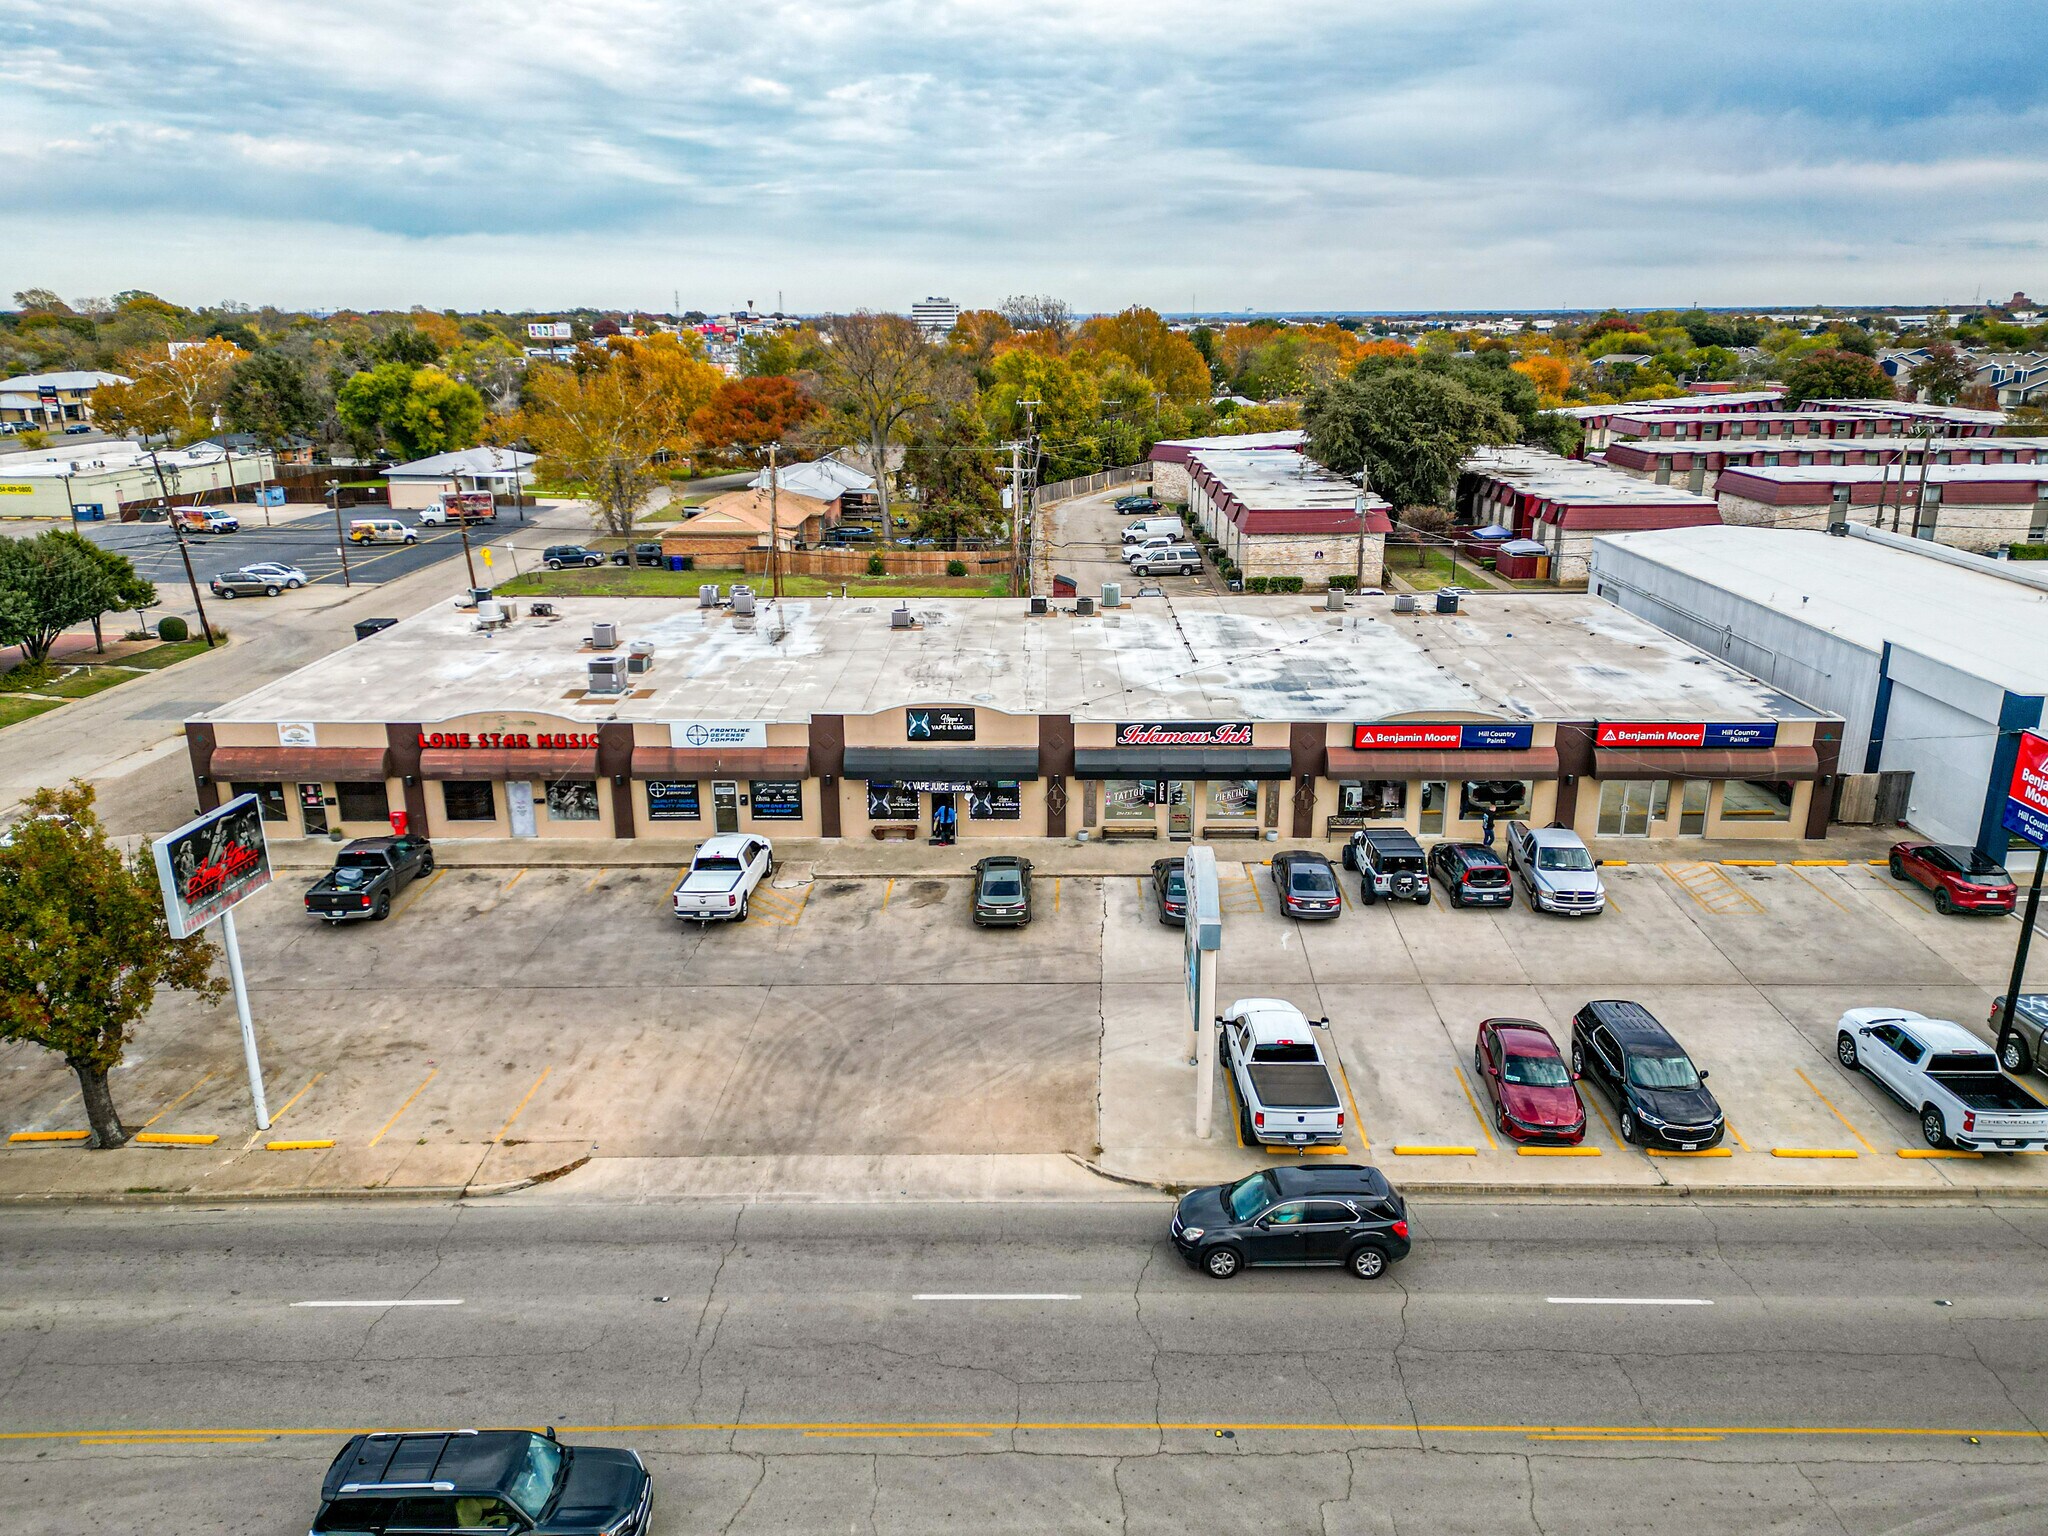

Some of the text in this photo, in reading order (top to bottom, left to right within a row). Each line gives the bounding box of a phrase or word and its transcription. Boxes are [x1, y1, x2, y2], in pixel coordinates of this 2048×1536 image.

[1118, 724, 1251, 744] Infamous Ink
[1376, 733, 1457, 743] Benjamin Moore
[1490, 731, 1516, 739] Country
[1618, 731, 1700, 742] Benjamin Moore
[1734, 729, 1760, 737] Country
[417, 732, 600, 749] LONE STAR MUSIC
[913, 781, 929, 790] VAPE
[930, 782, 949, 791] JUICE
[1114, 788, 1144, 801] TATTOO
[1215, 788, 1249, 801] PIERCING
[2017, 809, 2029, 822] Hill
[2023, 824, 2044, 841] Paints
